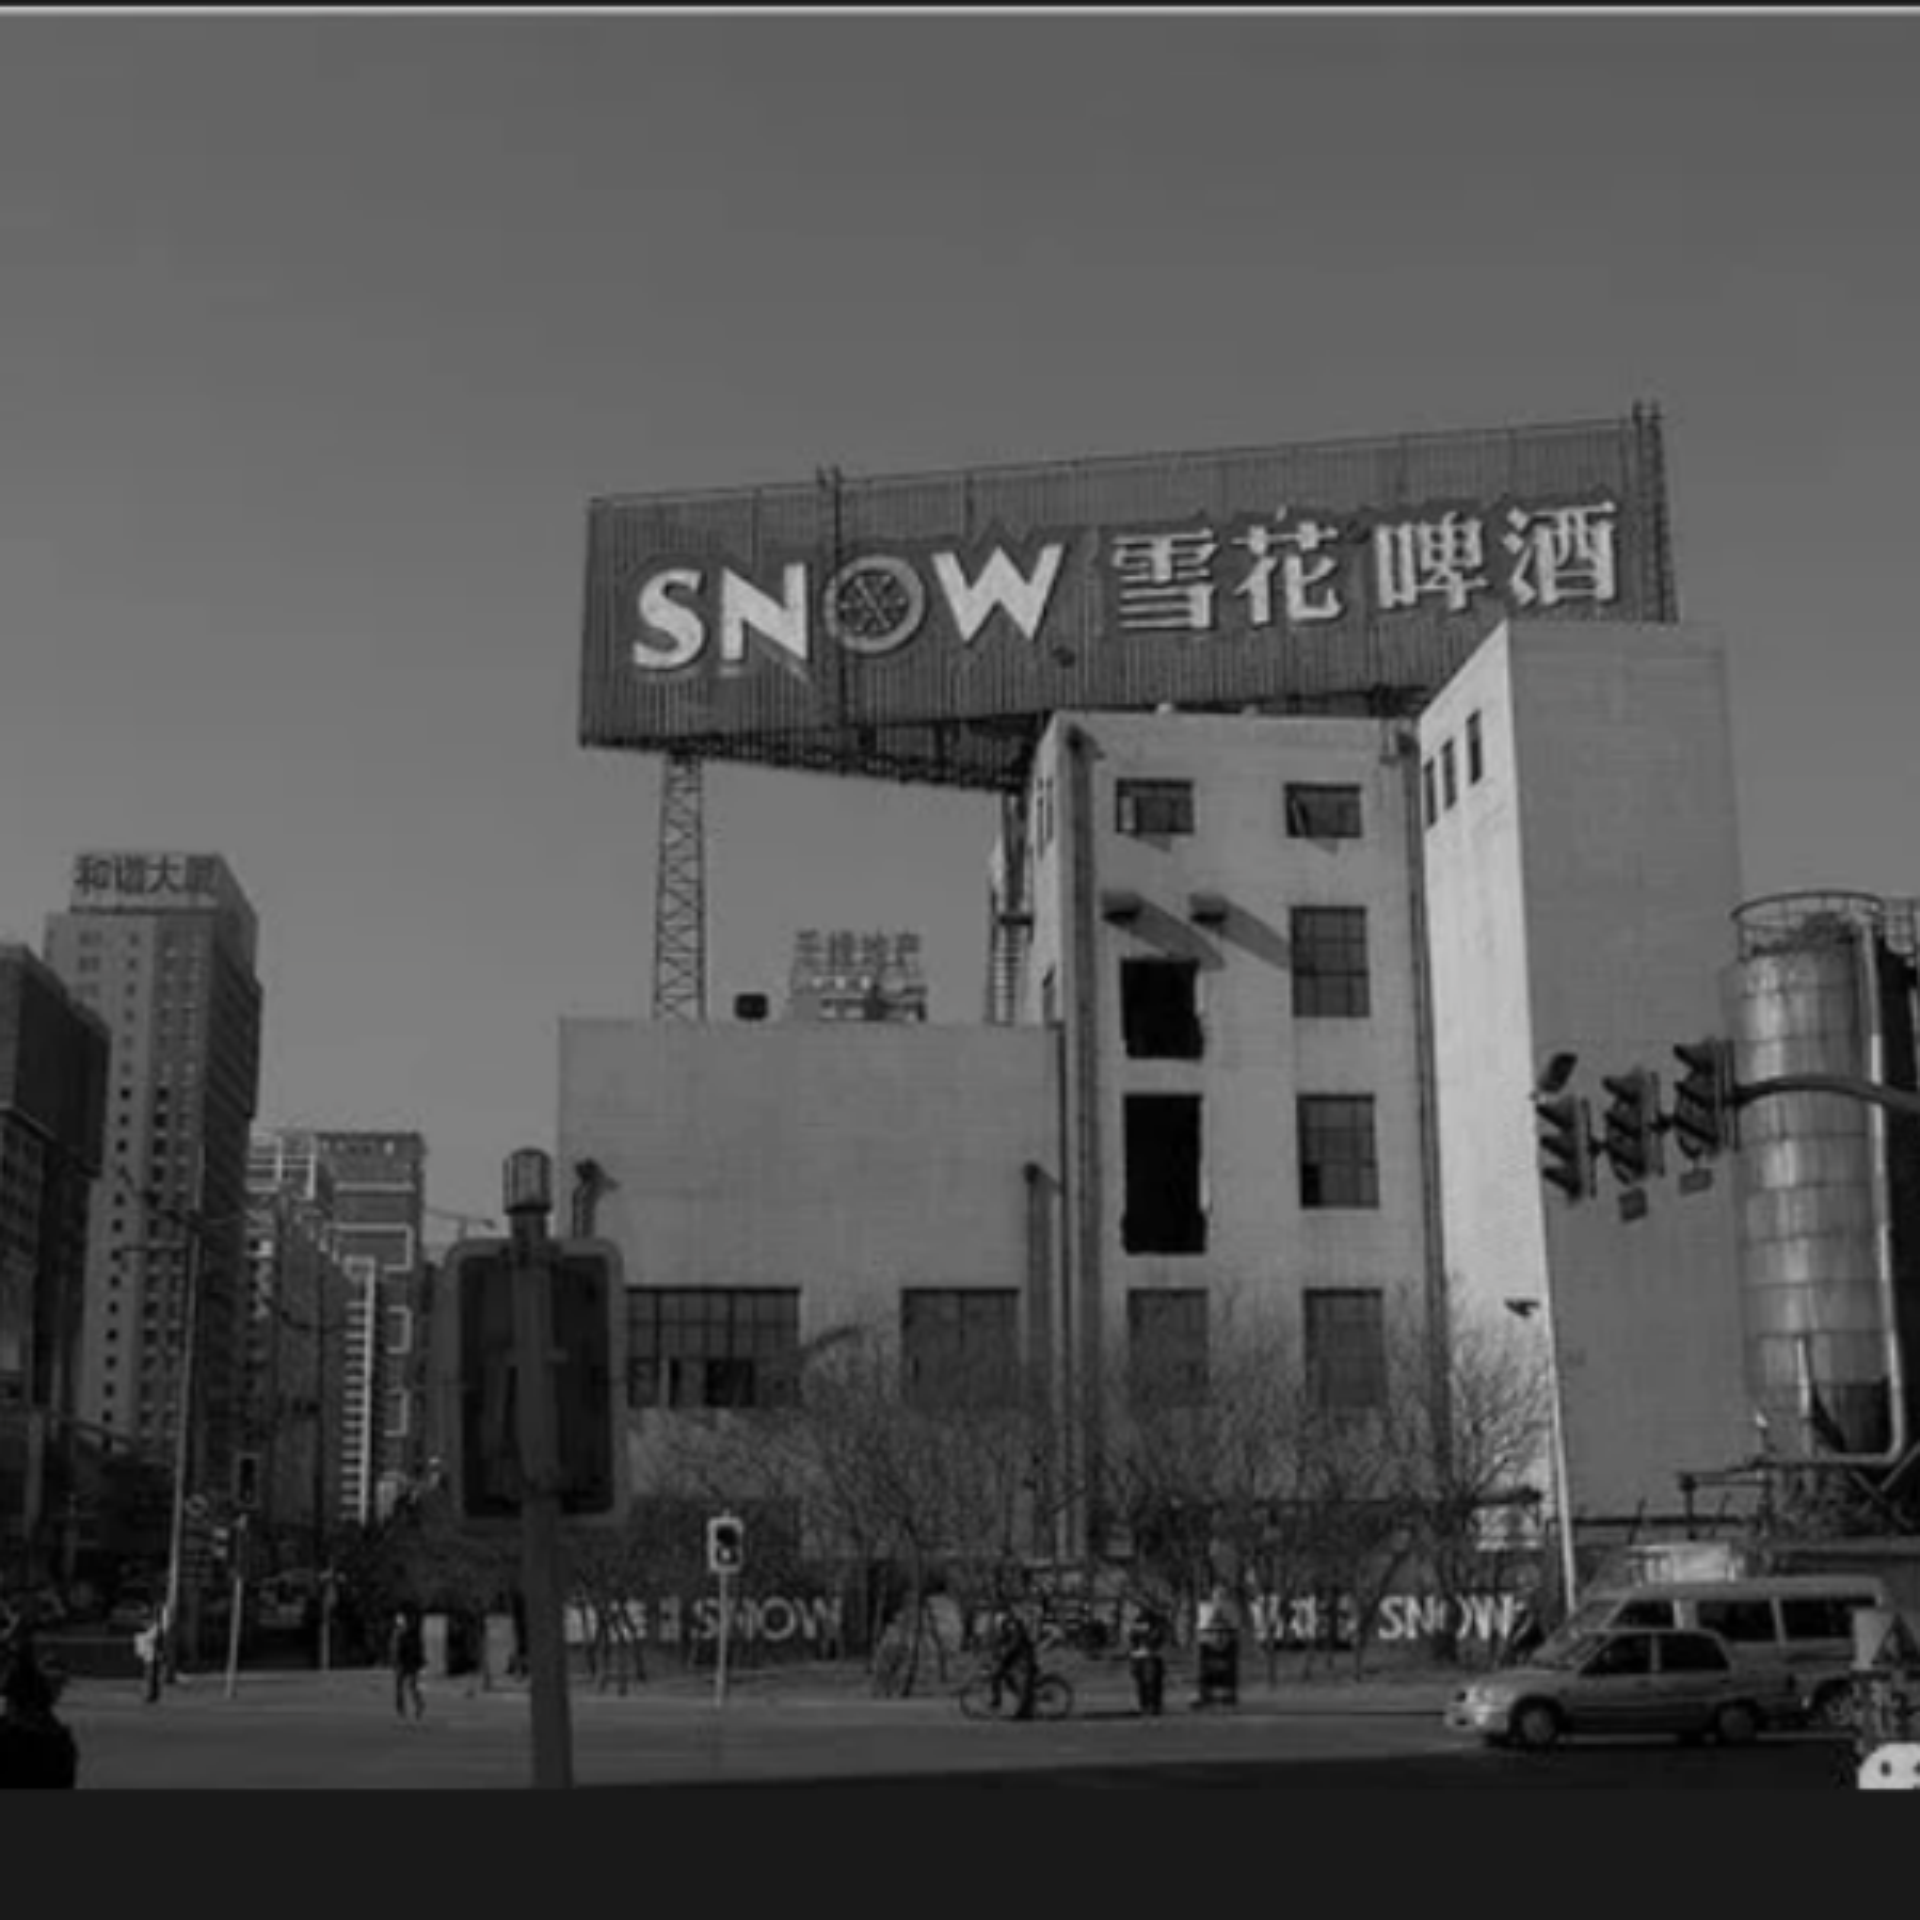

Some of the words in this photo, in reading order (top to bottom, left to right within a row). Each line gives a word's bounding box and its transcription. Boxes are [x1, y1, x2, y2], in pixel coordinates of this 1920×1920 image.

[633, 544, 1064, 668] SNOW
[1111, 501, 1616, 629] 雪花啤酒
